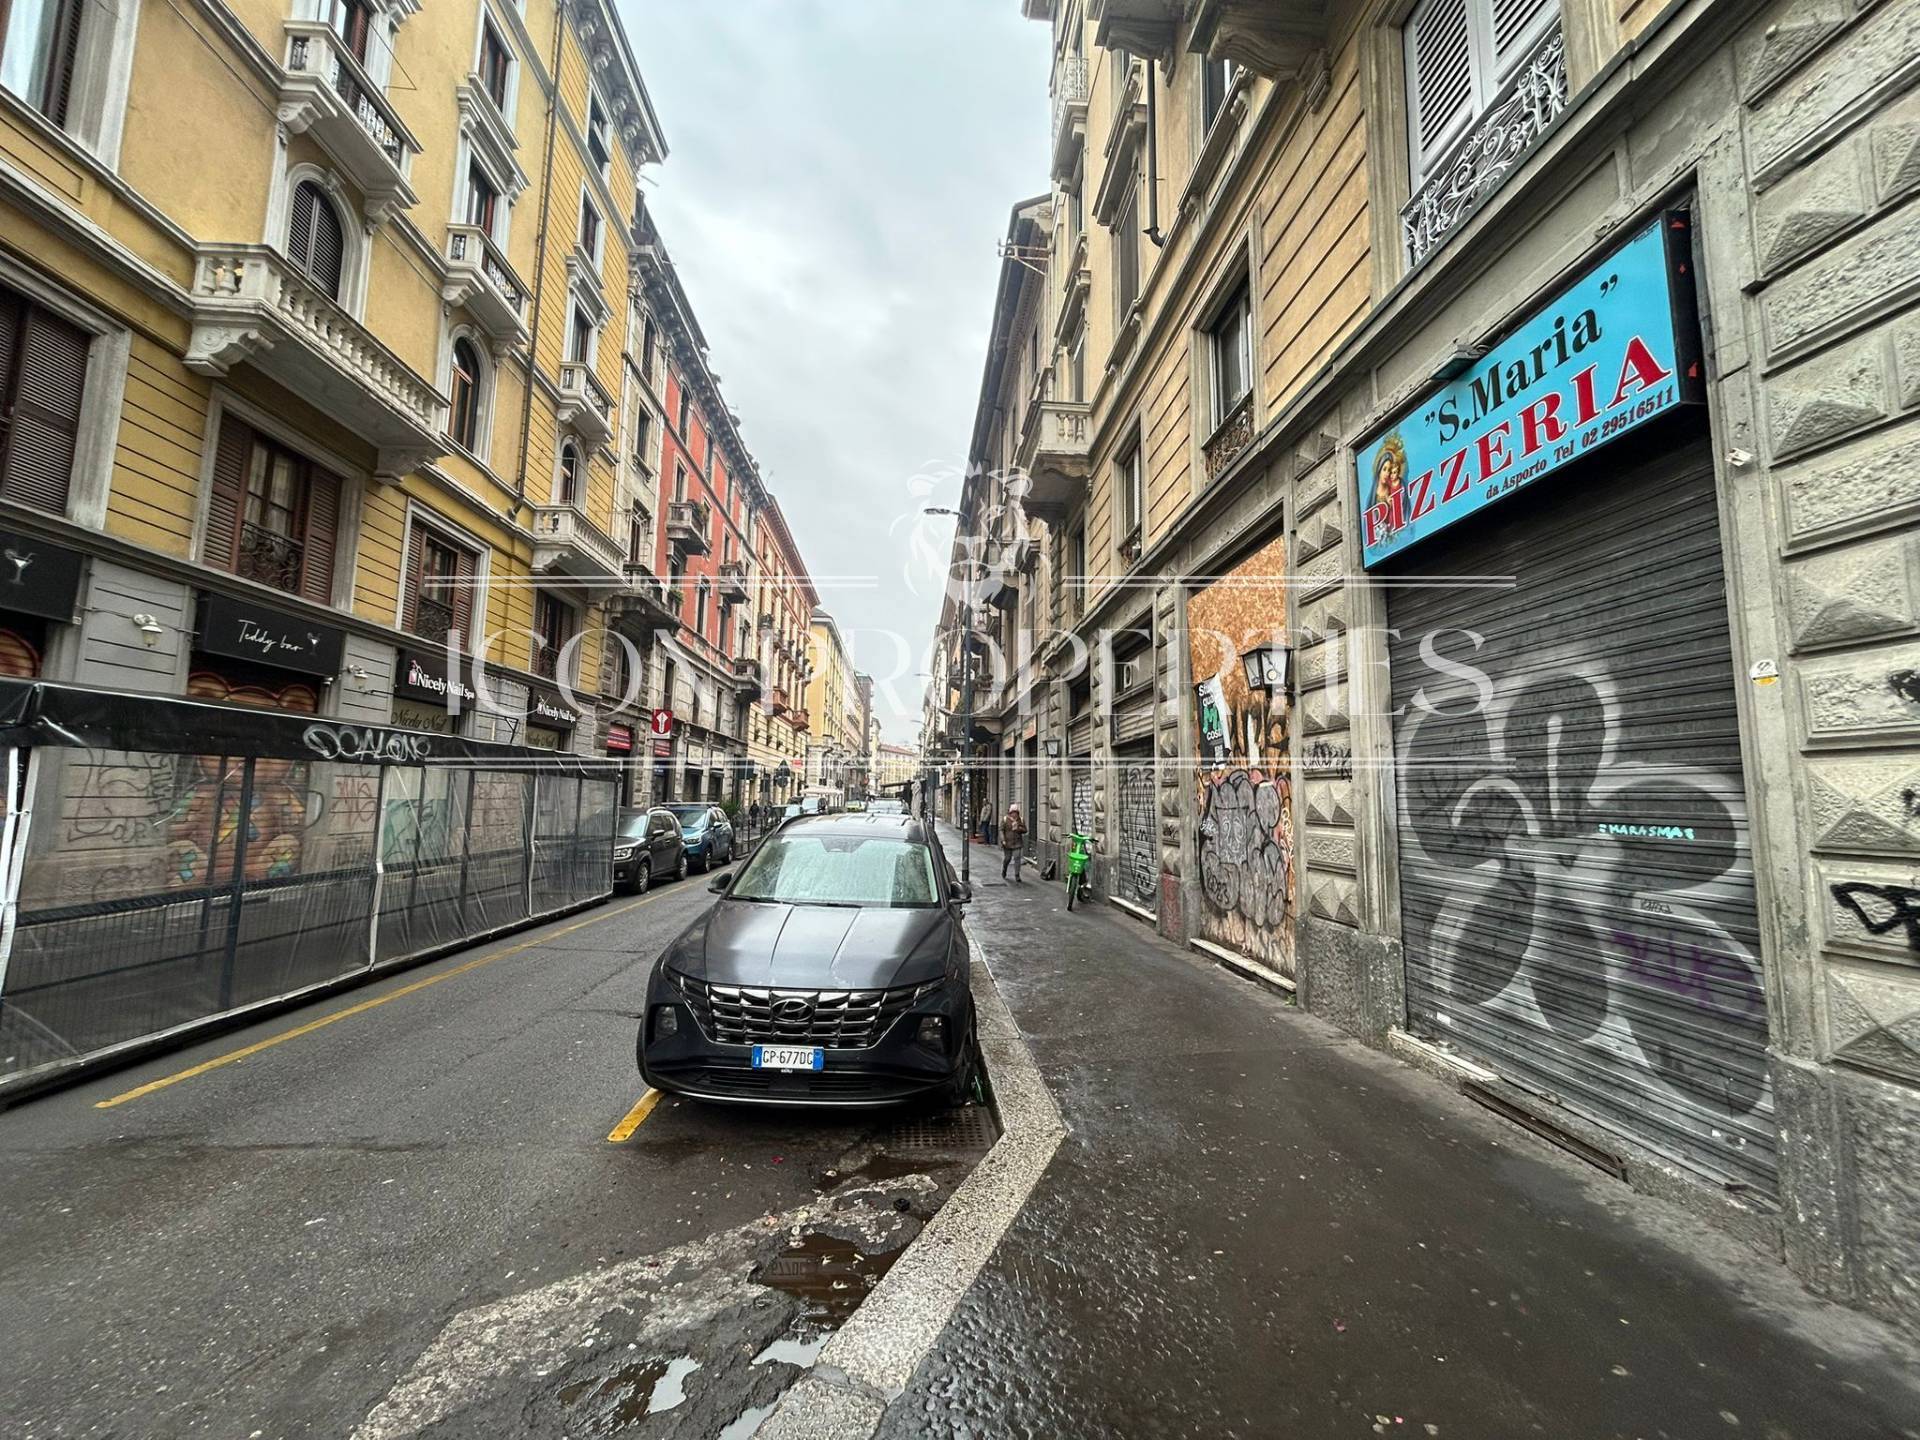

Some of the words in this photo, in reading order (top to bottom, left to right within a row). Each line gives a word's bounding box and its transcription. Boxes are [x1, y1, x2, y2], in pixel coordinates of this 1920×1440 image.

[1362, 336, 1673, 547] PIZZERIA
[1486, 483, 1499, 500] da
[1502, 458, 1547, 491] Asporto
[1553, 440, 1574, 464] Tel
[1582, 427, 1597, 448] 02
[1602, 385, 1673, 437] 29516511
[238, 619, 277, 653] Teddy
[416, 673, 447, 696] Nicely
[447, 680, 464, 697] Nail
